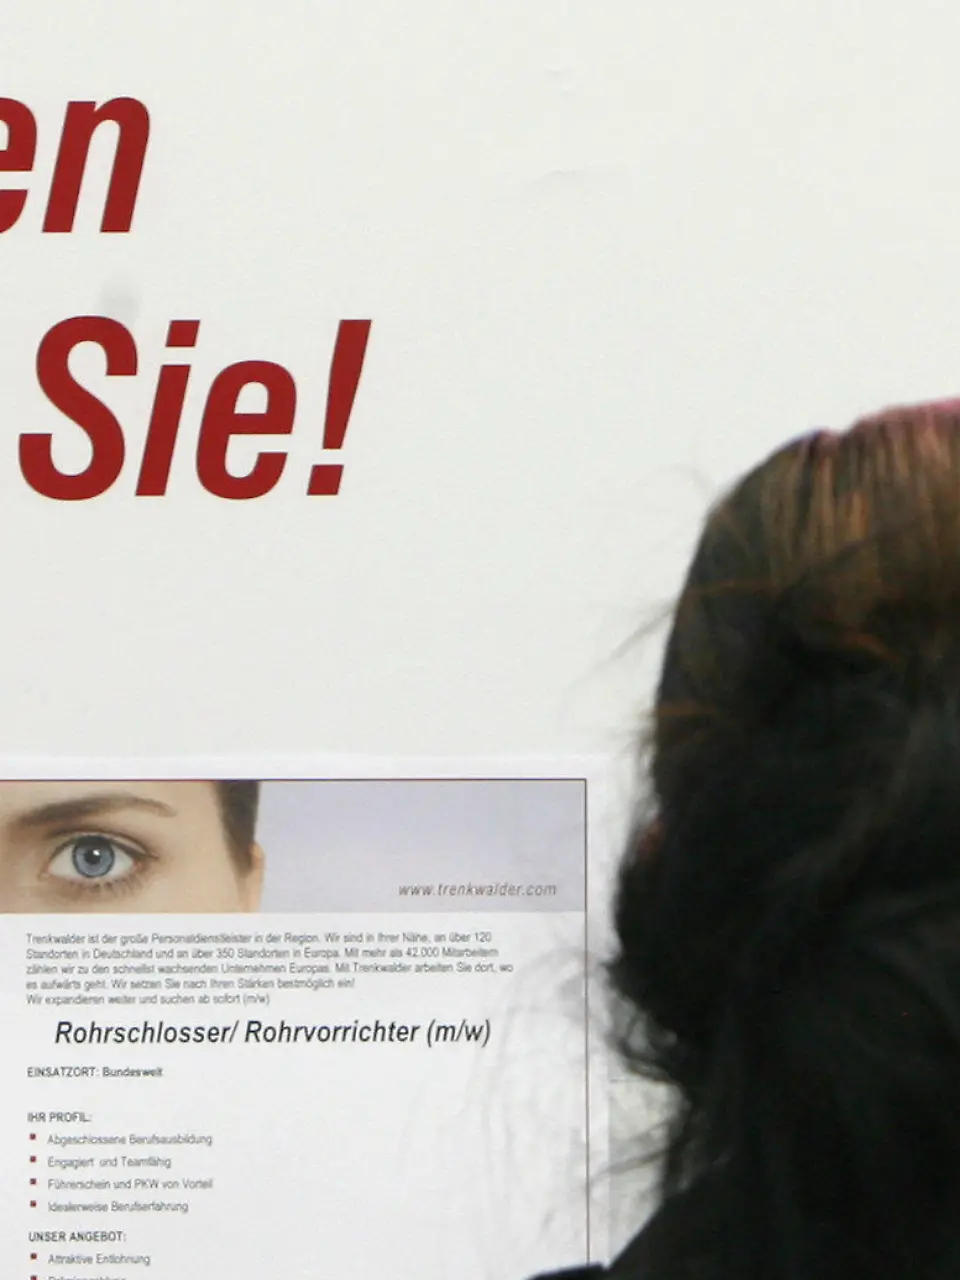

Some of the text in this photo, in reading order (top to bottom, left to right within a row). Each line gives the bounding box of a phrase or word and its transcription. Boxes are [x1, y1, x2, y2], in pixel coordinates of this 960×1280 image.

[19, 315, 372, 501] Sie!
[398, 882, 557, 897] www.trenkwalder.com
[54, 1019, 491, 1047] Rohrschlosser/ Rohrvorrichter (m/w)
[26, 1067, 163, 1078] EINSATZORT: Bundesweit
[28, 1112, 92, 1122] IHR PROFIL:
[28, 1231, 127, 1242] UNSER ANGEBOT:
